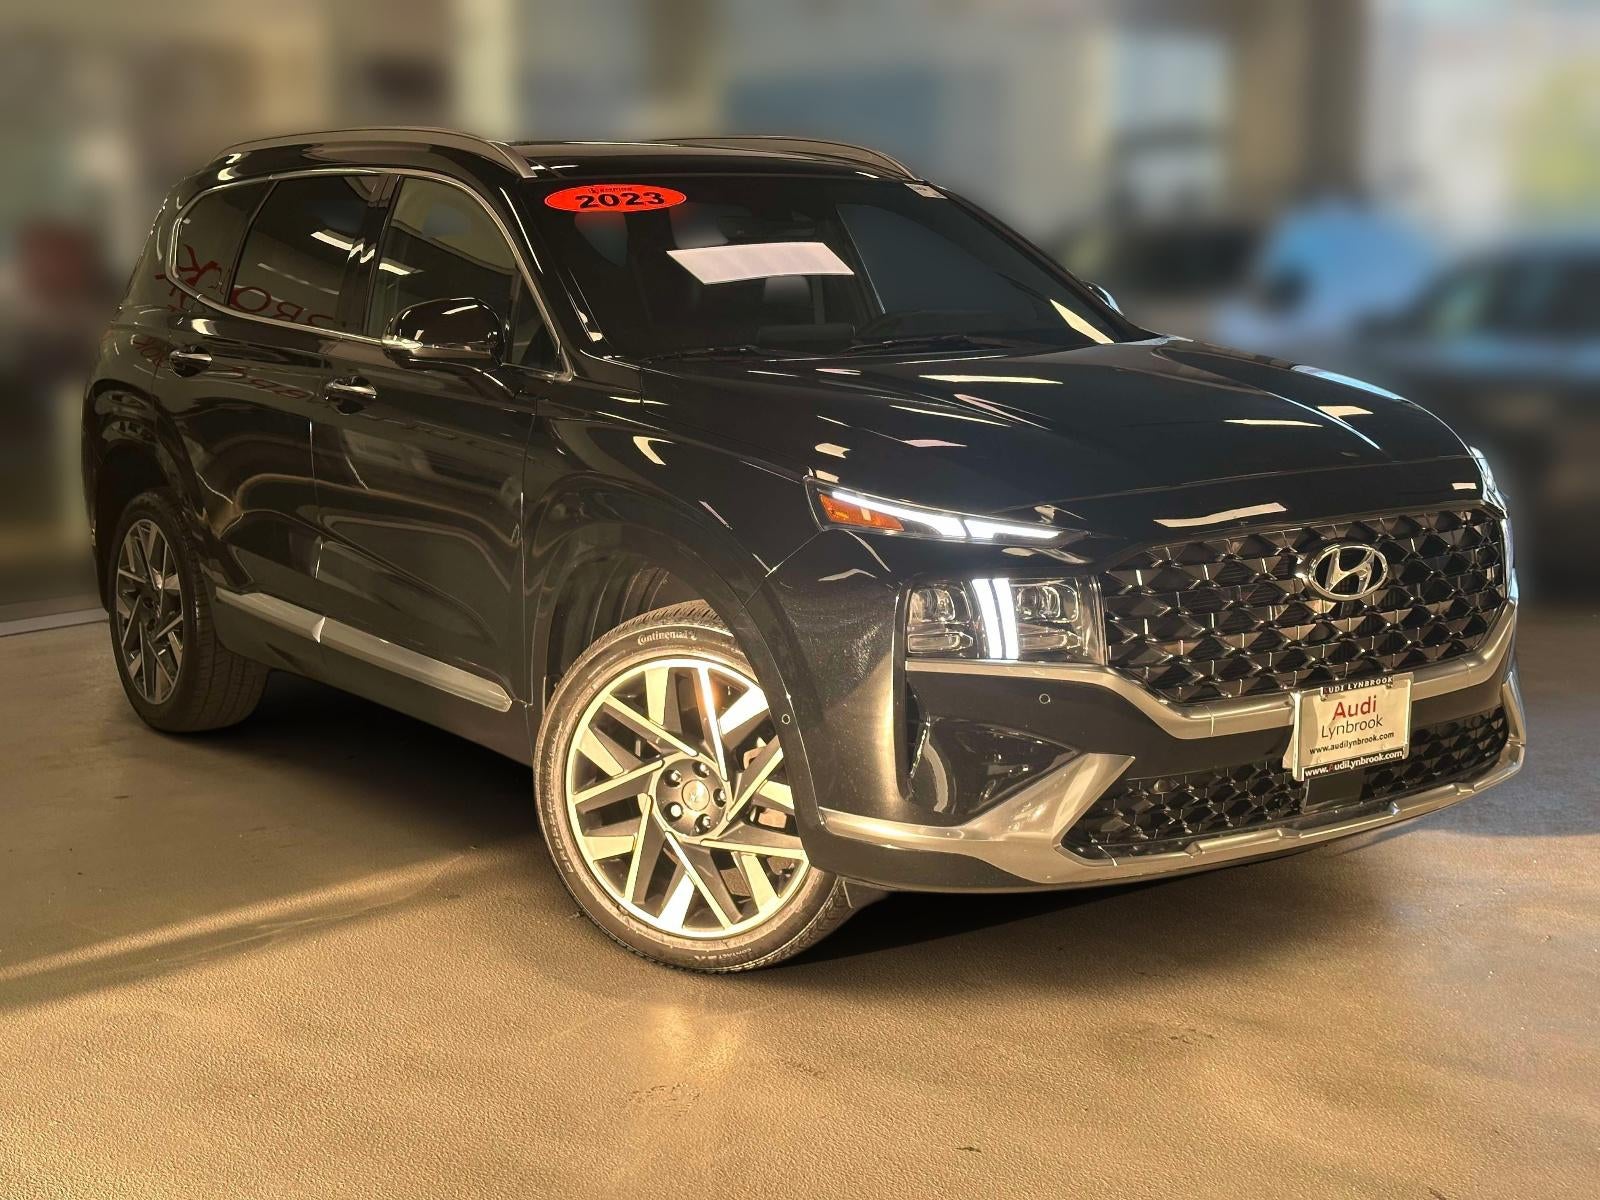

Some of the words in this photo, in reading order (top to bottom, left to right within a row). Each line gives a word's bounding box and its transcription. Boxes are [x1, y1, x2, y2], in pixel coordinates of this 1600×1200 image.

[575, 191, 666, 209] 2023
[1347, 676, 1393, 691] LYNBROOK
[1332, 694, 1377, 721] Audi
[1321, 714, 1384, 740] Lynbrook
[1309, 731, 1395, 755] www.audilynbrook.com
